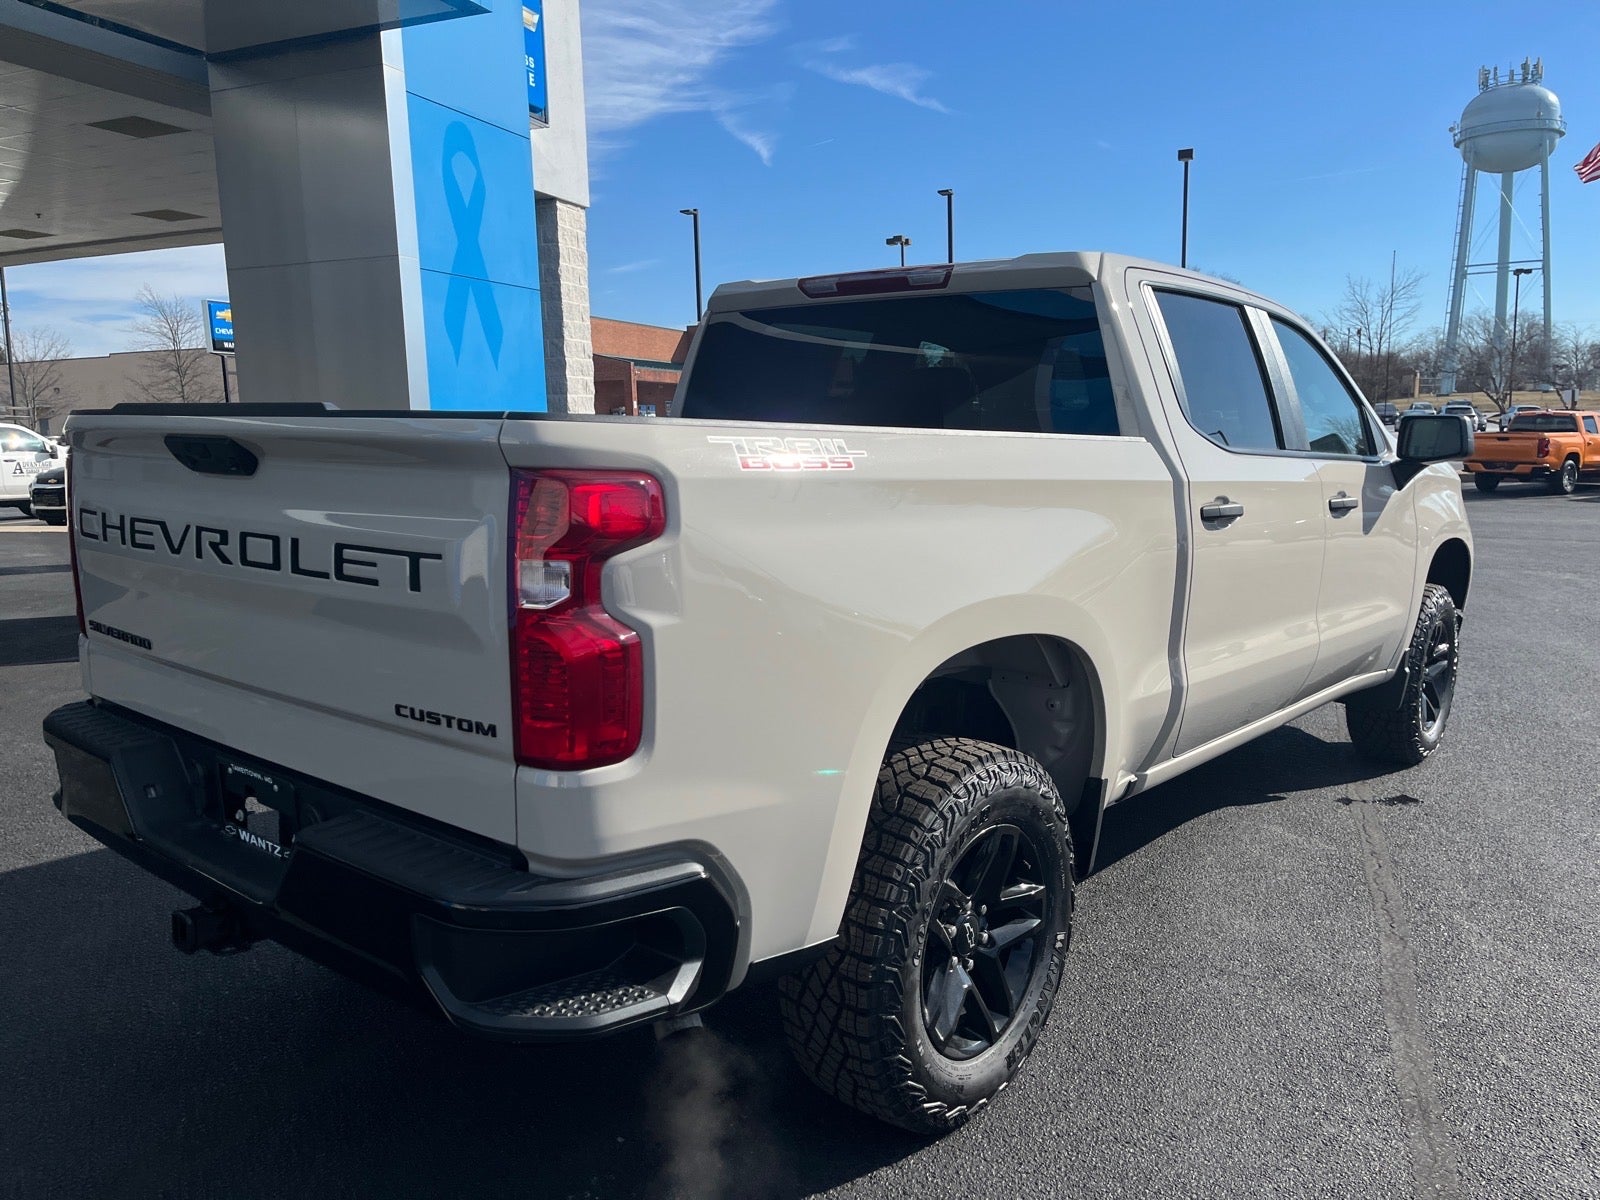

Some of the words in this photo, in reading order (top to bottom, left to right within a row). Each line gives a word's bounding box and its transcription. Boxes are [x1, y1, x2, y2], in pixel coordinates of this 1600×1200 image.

[706, 435, 868, 457] TRAIL
[738, 455, 855, 471] BOSS
[79, 507, 443, 593] CHEVROLET
[88, 619, 152, 650] SILVERADO
[394, 703, 498, 738] CUSTOM
[238, 828, 282, 857] WANTZ
